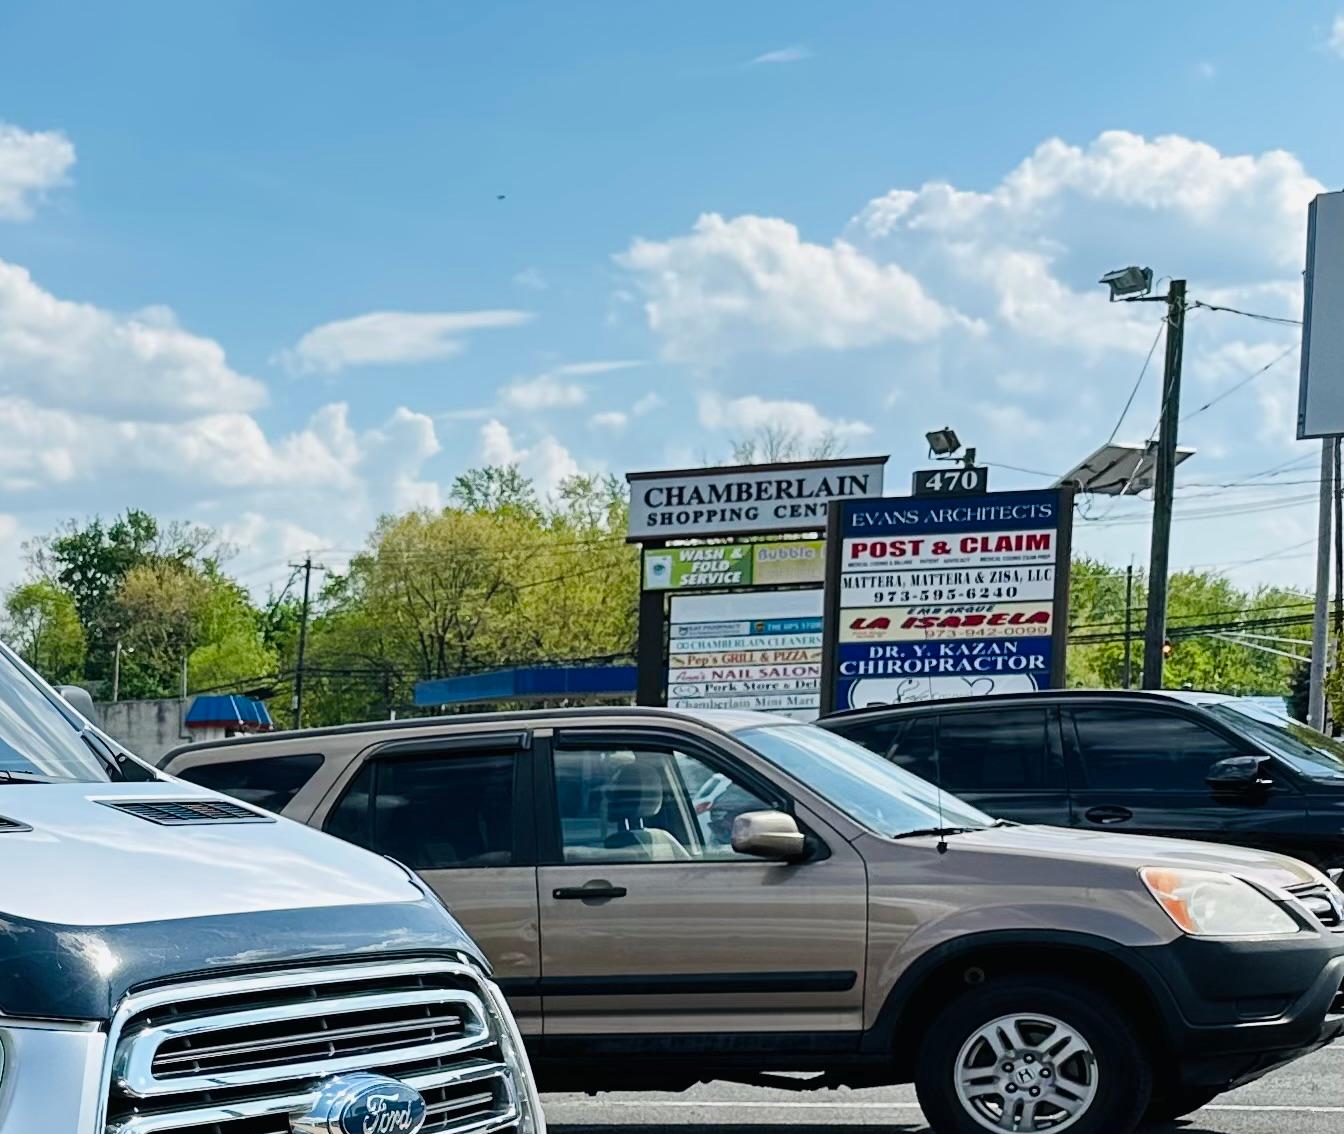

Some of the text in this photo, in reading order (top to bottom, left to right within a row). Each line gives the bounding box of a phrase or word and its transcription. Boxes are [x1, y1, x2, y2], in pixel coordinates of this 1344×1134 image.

[925, 470, 978, 492] 470
[644, 474, 869, 508] CHAMBERLAIN
[647, 501, 828, 527] SHOPPING CENT
[852, 503, 1053, 527] EVANS ARCHITECTS
[680, 548, 744, 562] WASH &
[758, 547, 814, 561] Bubble
[851, 539, 925, 560] POST
[931, 541, 952, 556] &
[960, 533, 1051, 555] CLAIM
[691, 560, 730, 574] FOLD
[679, 572, 742, 587] SERVICE
[843, 568, 1052, 589] MATTERA, MATTERA & ZISA, LLC
[874, 586, 1017, 603] 973-595-6240
[849, 611, 1050, 630] LA ISABELA
[925, 626, 1048, 639] 973-942-0099
[690, 634, 822, 650] CHAMBERLAIN CLEANERS
[869, 641, 1018, 659] DR. Y. KAZAN
[687, 650, 809, 668] Pep's GRILL & PIZZA
[839, 654, 1046, 676] CHIROPRACTOR
[712, 669, 754, 680] NAIL
[759, 666, 820, 678] SALON
[705, 682, 737, 693] Pork
[744, 681, 779, 690] Store
[795, 679, 818, 689] Del
[675, 699, 751, 710] Chamberlain
[786, 696, 815, 705] Mart
